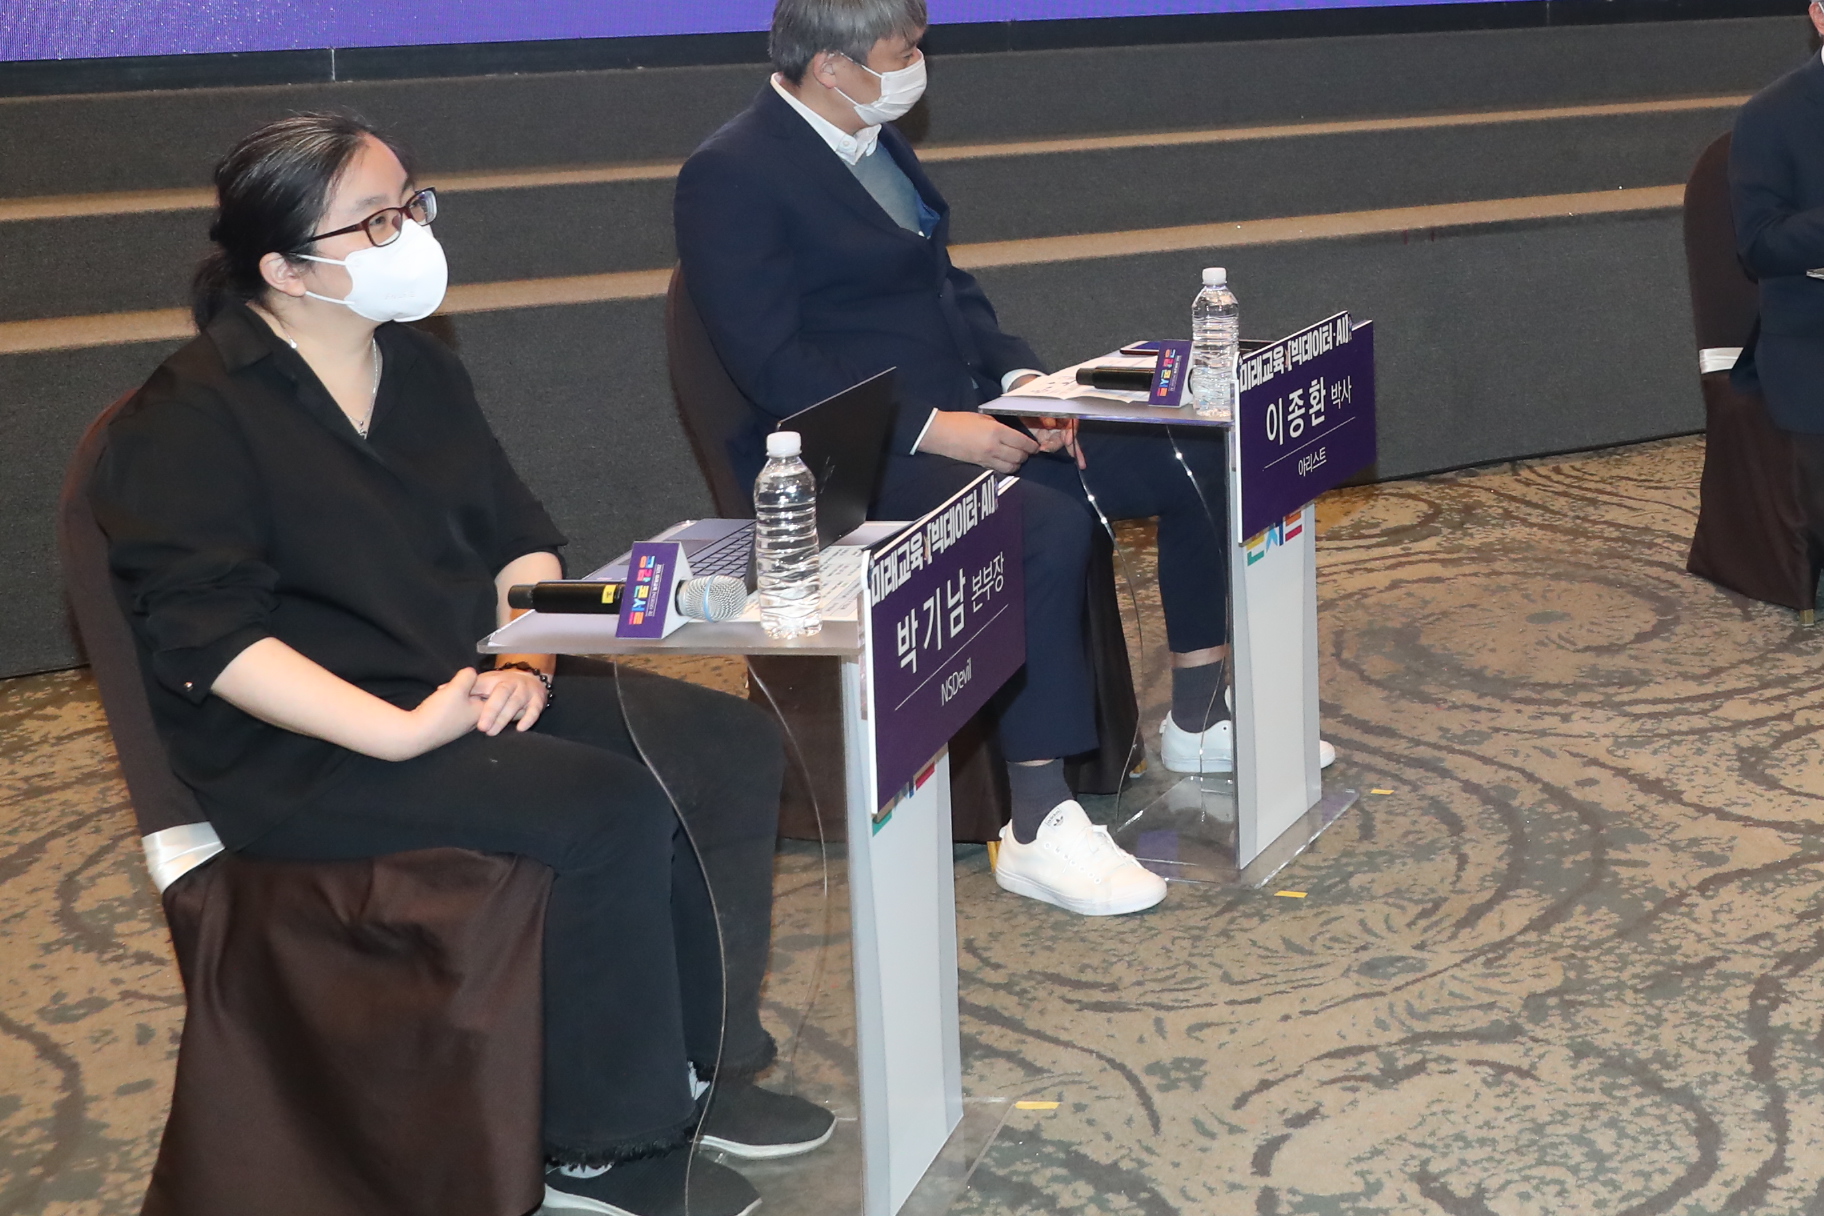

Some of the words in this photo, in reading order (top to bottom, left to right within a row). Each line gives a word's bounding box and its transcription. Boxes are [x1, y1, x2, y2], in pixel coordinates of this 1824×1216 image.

[1239, 345, 1285, 393] 미래교육
[1330, 376, 1352, 409] 박사
[1298, 447, 1327, 477] 아리스트
[871, 531, 924, 607] 미래교육
[971, 551, 1004, 613] 본부장
[941, 657, 972, 706] NSDevil
